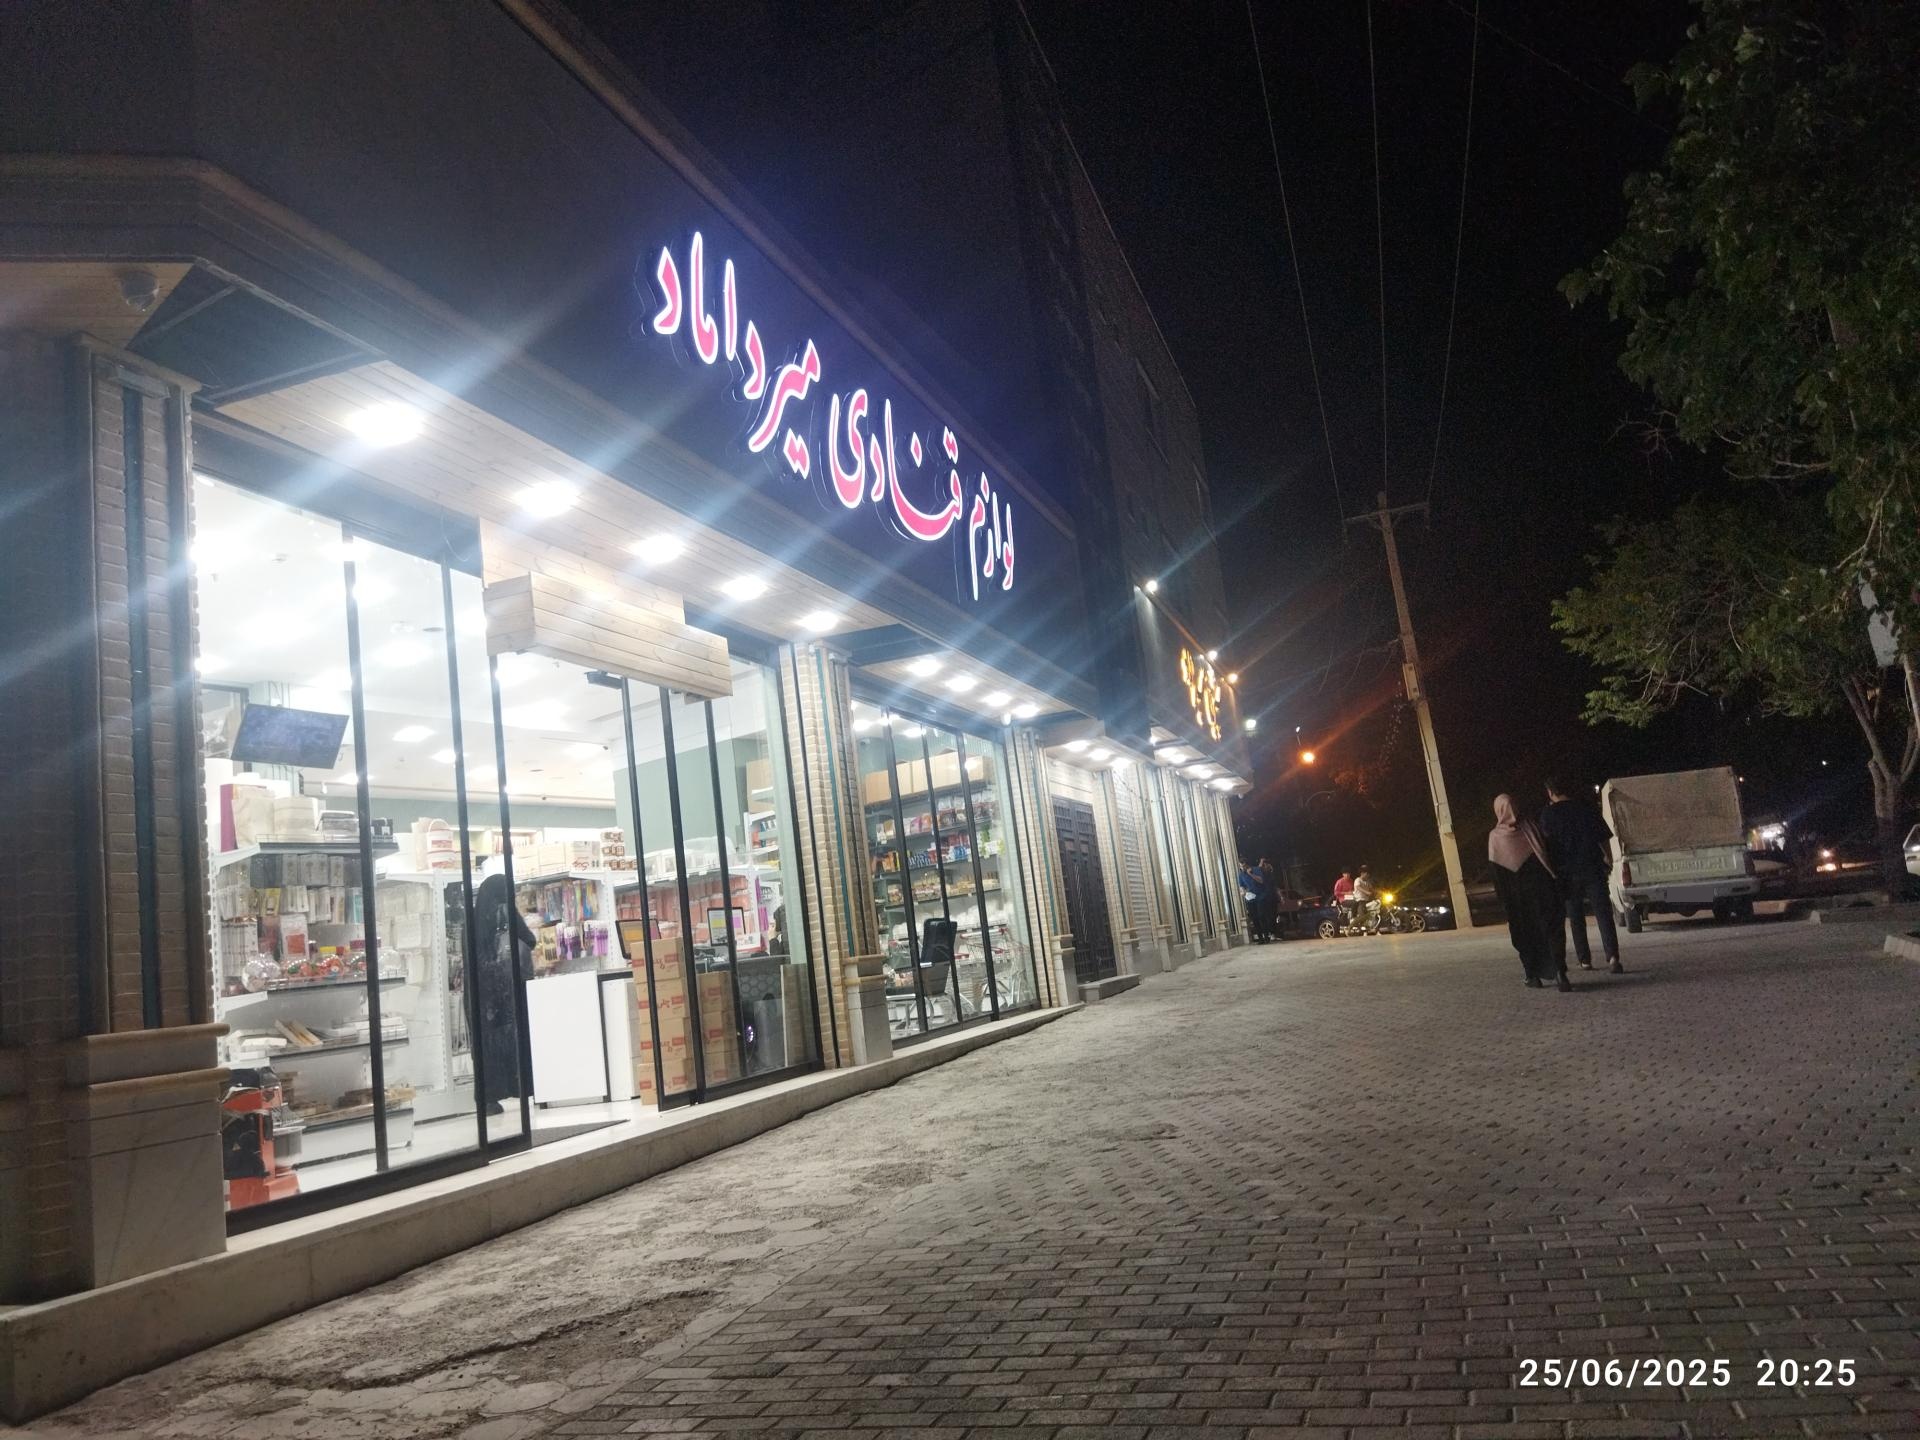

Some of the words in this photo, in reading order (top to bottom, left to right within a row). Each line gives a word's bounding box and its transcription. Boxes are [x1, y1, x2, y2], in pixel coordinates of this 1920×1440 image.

[653, 231, 821, 479] میرداماد
[828, 388, 963, 541] قنادی
[969, 471, 1015, 601] لوازم
